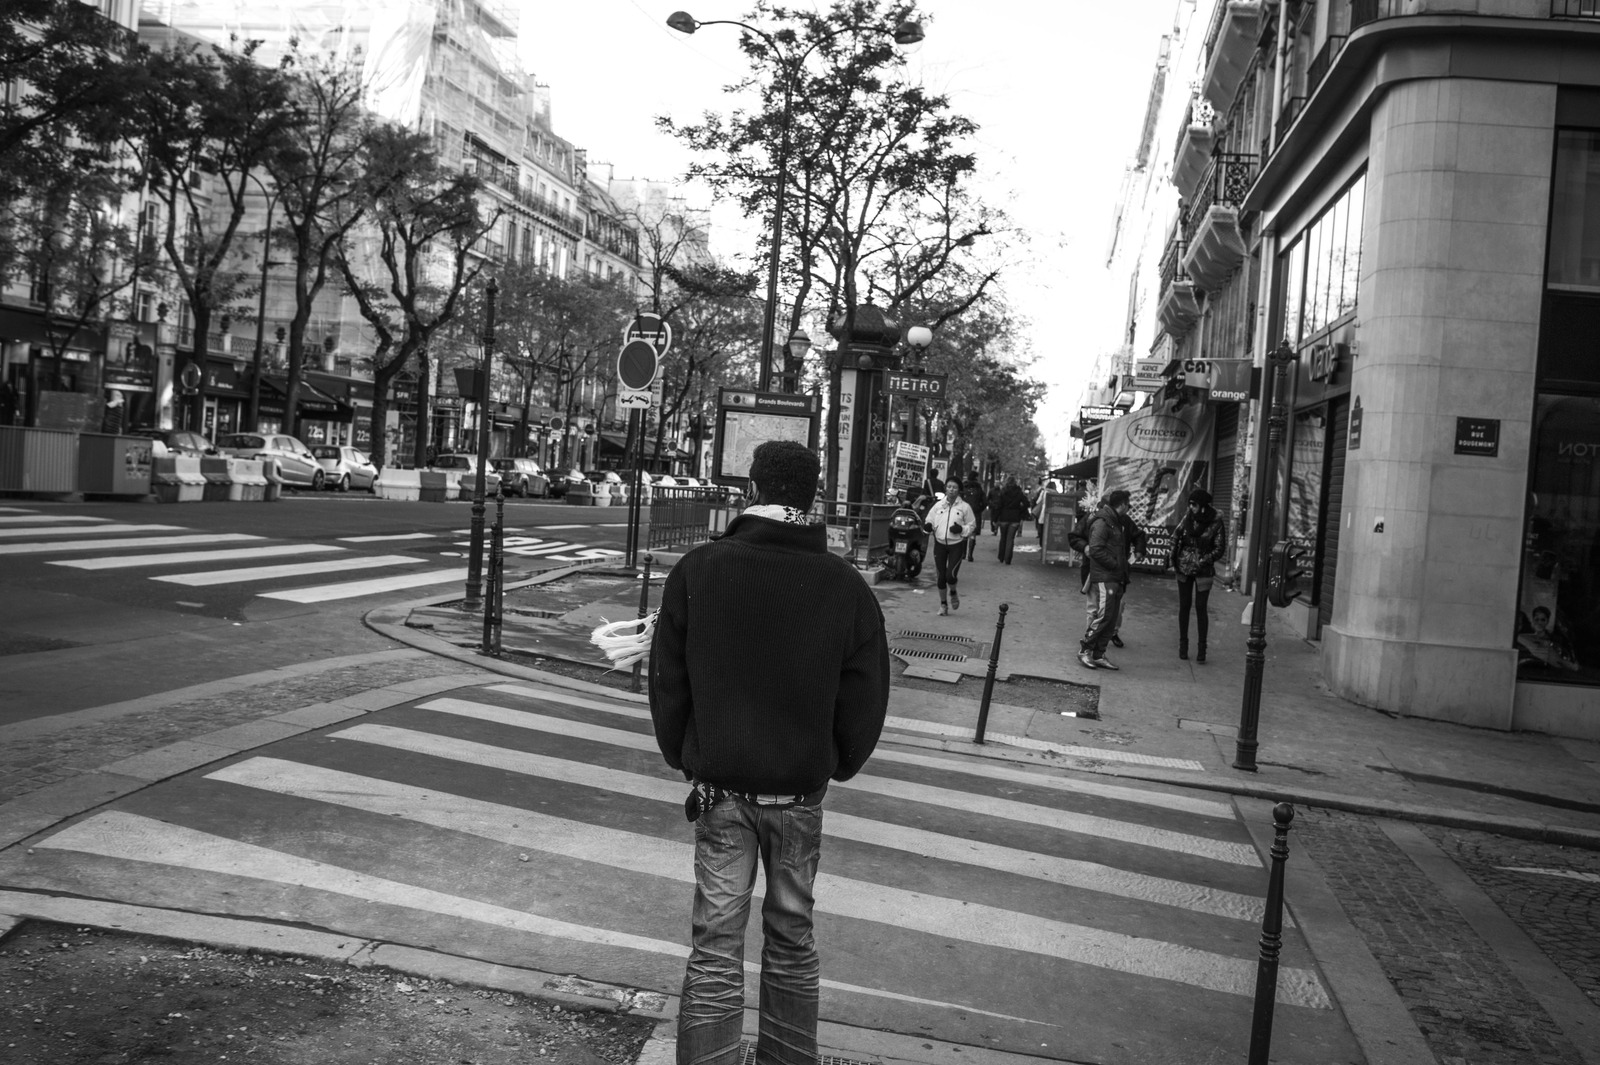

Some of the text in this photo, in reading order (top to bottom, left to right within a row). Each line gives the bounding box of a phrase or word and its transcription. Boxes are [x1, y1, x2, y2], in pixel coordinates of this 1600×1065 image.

[889, 376, 940, 393] METRO
[396, 391, 409, 399] SFR
[1211, 390, 1246, 401] orange
[777, 399, 805, 407] Boulevards
[1134, 423, 1187, 438] francesca
[1458, 439, 1495, 448] ROUGEMONT
